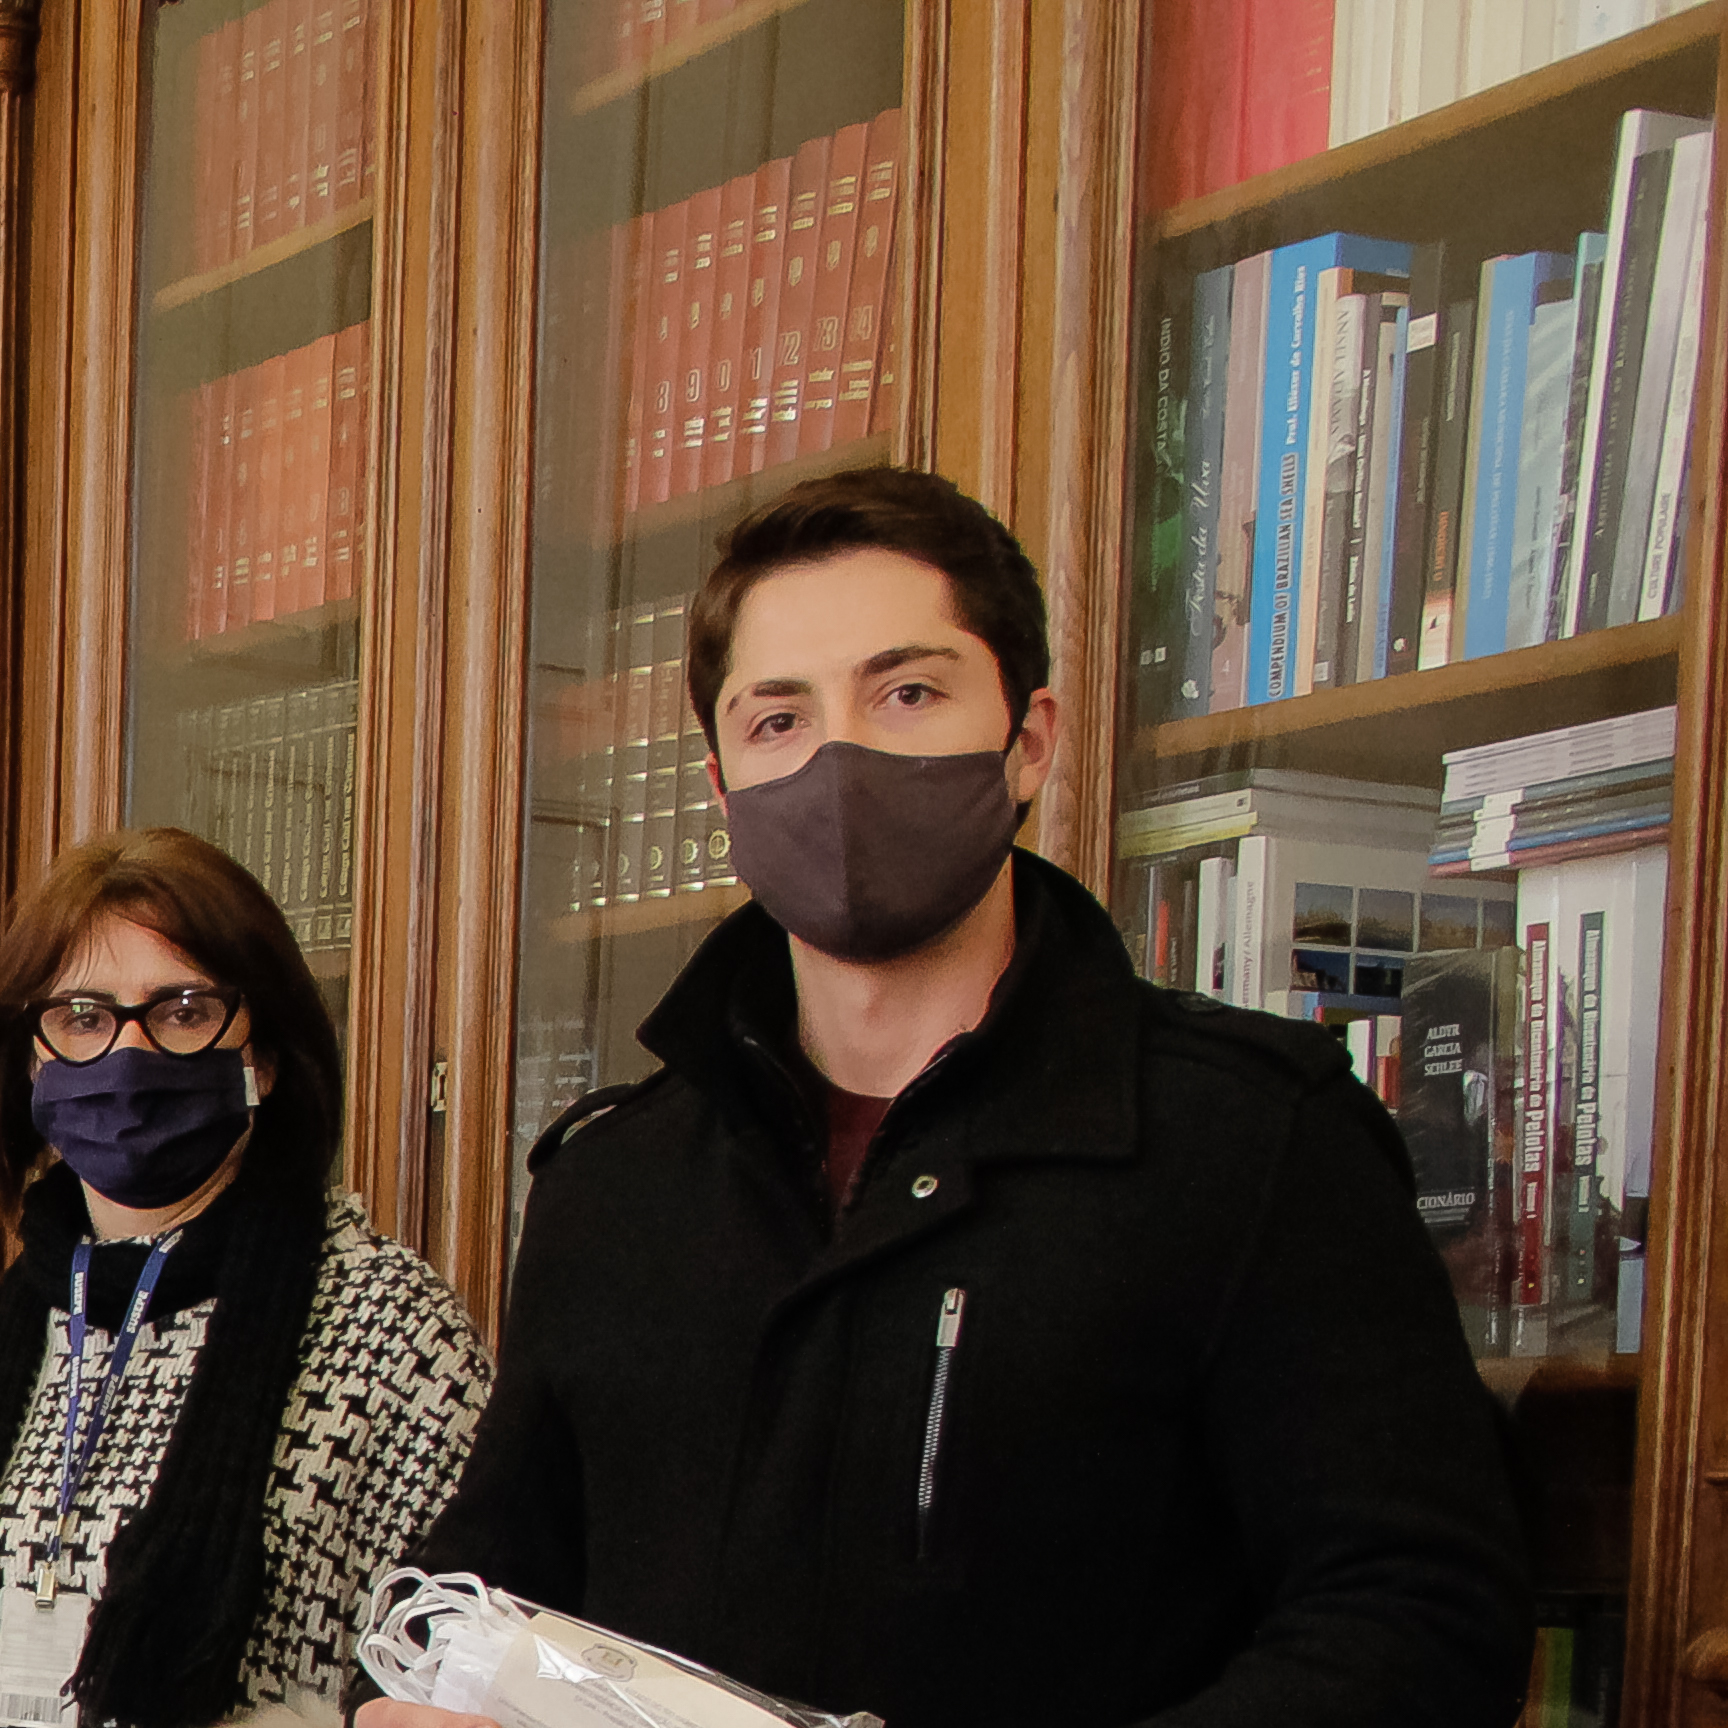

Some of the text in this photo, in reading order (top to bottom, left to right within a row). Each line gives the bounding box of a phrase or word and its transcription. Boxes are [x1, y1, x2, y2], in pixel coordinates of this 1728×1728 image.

[1158, 368, 1169, 392] DA
[1154, 395, 1168, 450] COSTA
[1279, 496, 1293, 521] SEA
[1274, 522, 1292, 590] BRAZILIAN
[1274, 592, 1287, 610] OF
[1268, 610, 1287, 698] COMPENDIUM
[1240, 956, 1252, 1008] ermany
[1524, 1108, 1543, 1173] Pelotas
[1574, 1100, 1596, 1167] Pelotas
[1417, 1191, 1476, 1210] CIONÁRIO
[125, 1290, 150, 1335] SUSEPE
[100, 1375, 120, 1417] SUSEPE
